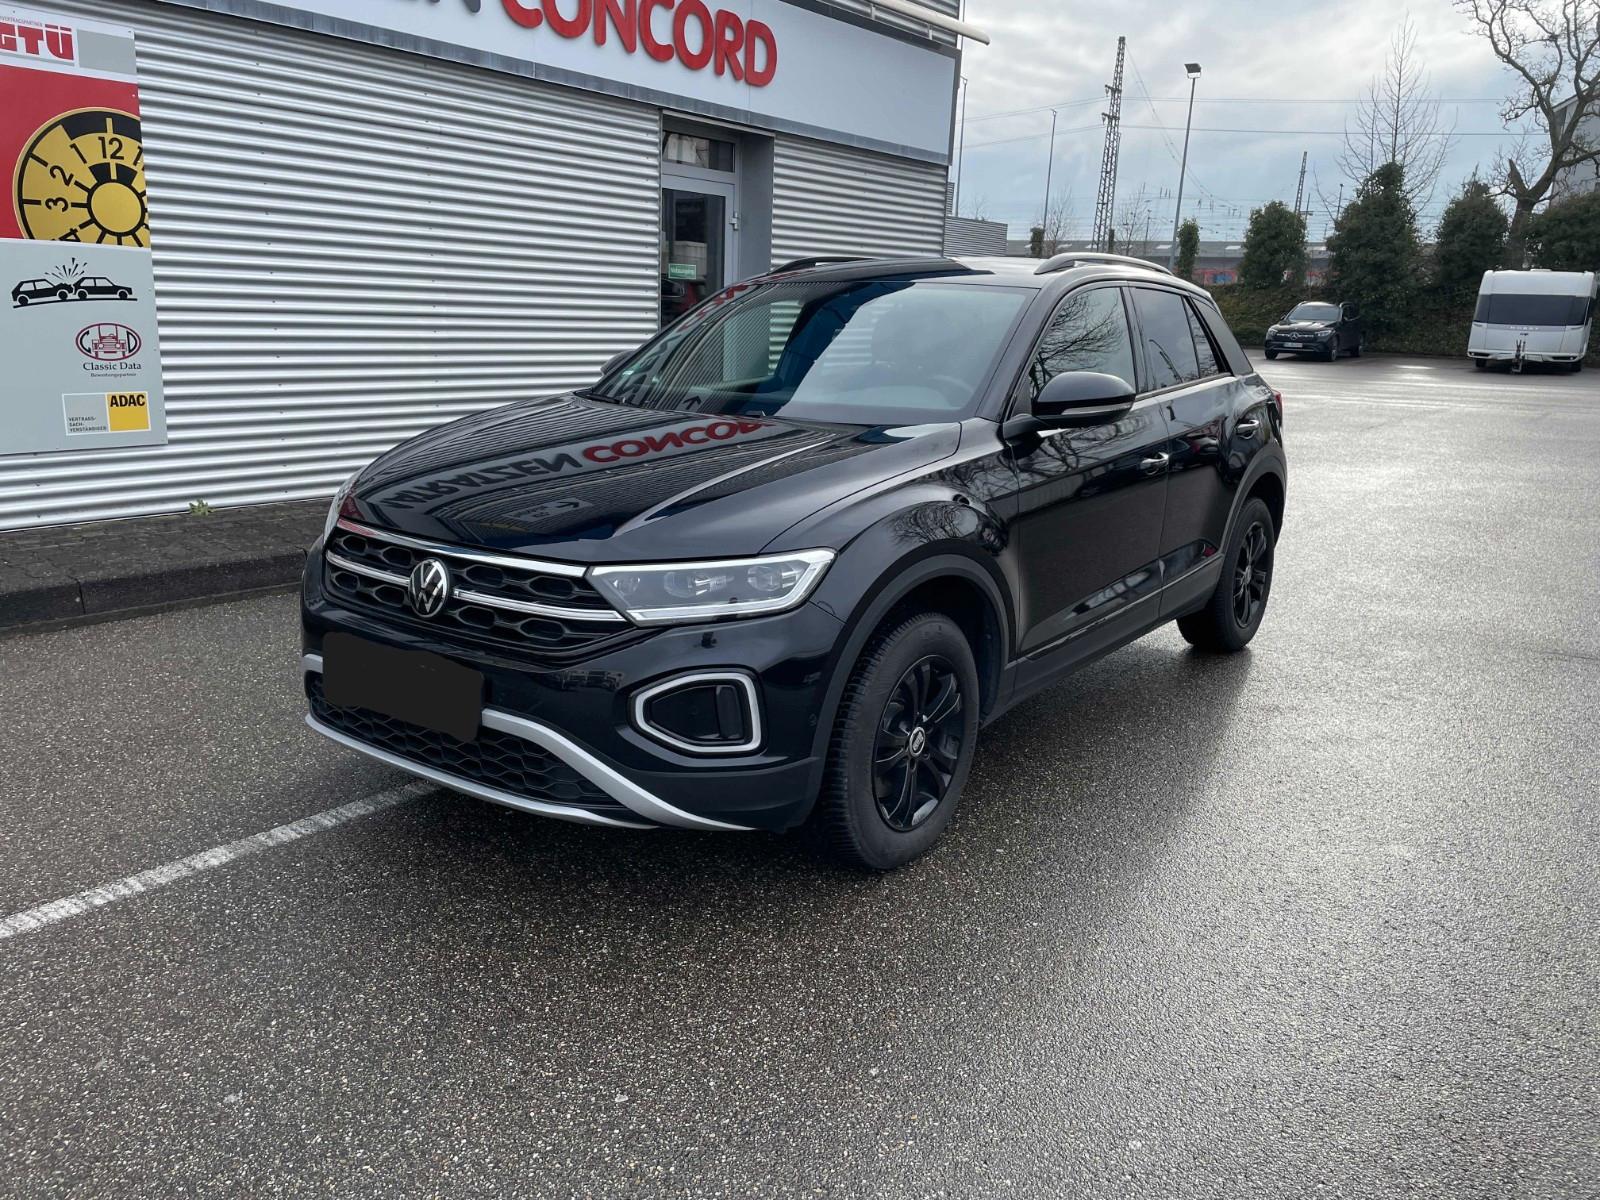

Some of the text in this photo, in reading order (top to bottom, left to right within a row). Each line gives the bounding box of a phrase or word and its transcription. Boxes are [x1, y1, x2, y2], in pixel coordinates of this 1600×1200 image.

[98, 136, 124, 160] 12
[49, 165, 74, 187] 2
[45, 196, 69, 213] 3
[83, 361, 142, 372] Classic Data
[110, 394, 146, 408] ADAC
